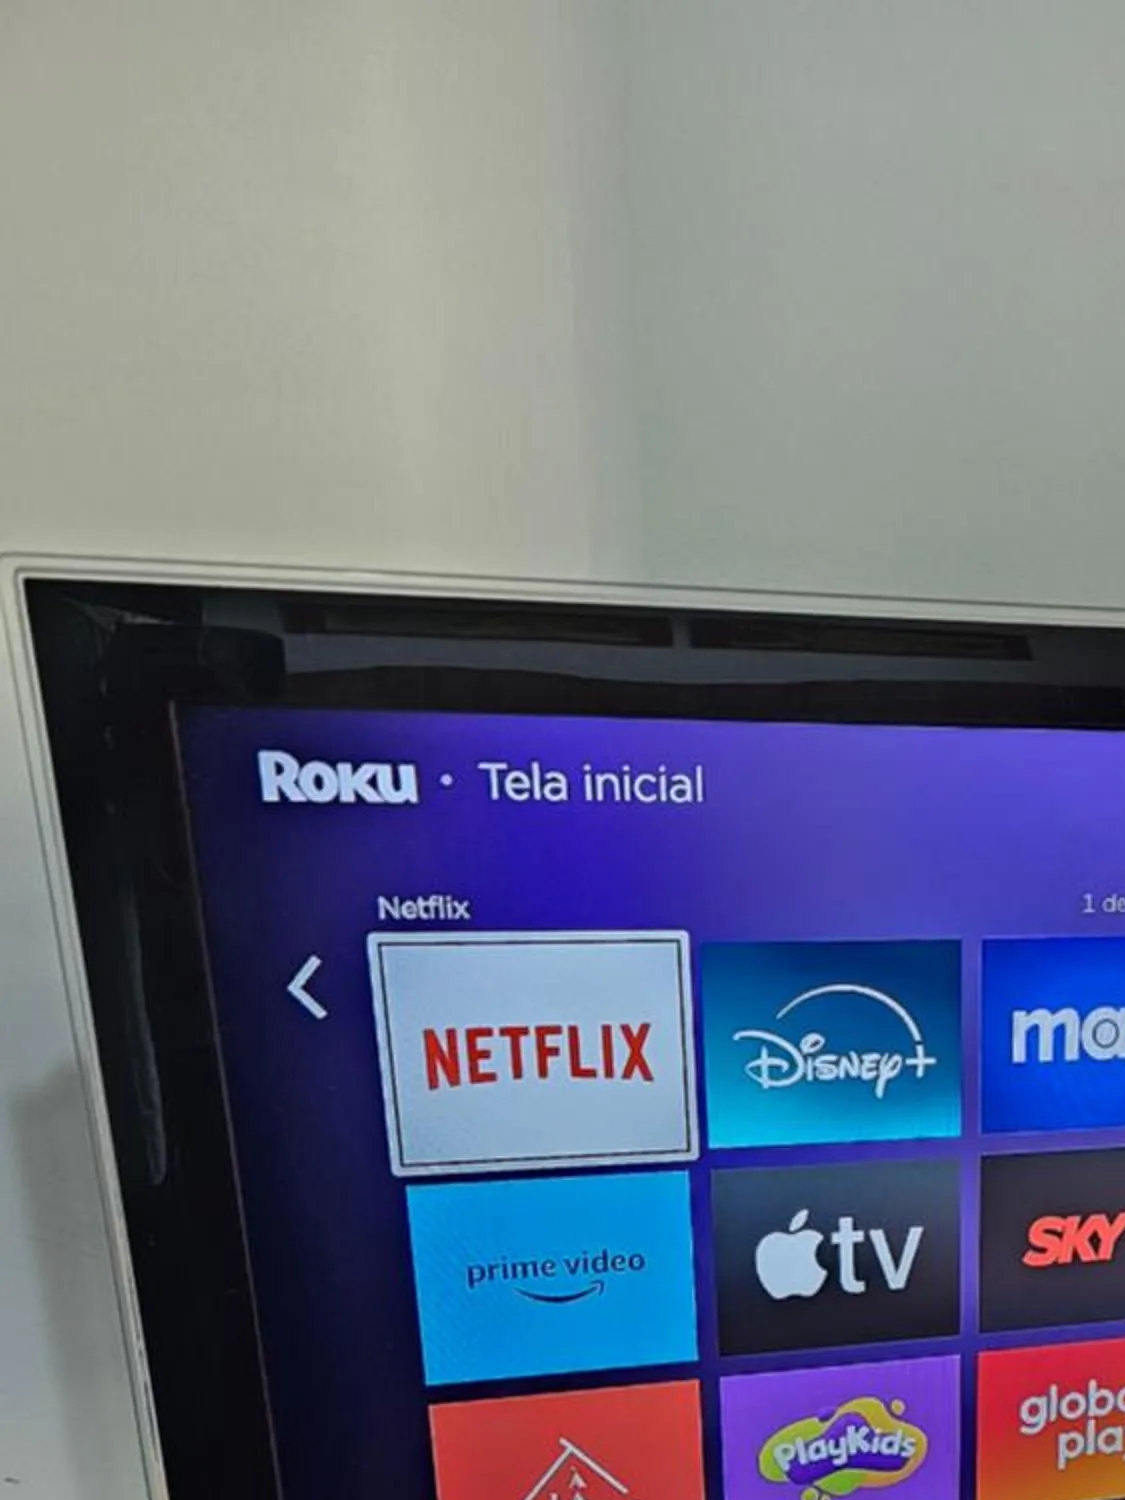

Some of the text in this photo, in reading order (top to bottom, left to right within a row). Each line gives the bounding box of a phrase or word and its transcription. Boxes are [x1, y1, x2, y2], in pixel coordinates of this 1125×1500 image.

[478, 761, 568, 802] Tela
[583, 764, 705, 803] inicial
[377, 895, 471, 921] Netflix
[1082, 893, 1096, 912] 1
[423, 1023, 654, 1090] NETFLIX
[466, 1248, 646, 1290] prime video
[831, 1215, 924, 1294] tv
[773, 1424, 918, 1472] PlayKids
